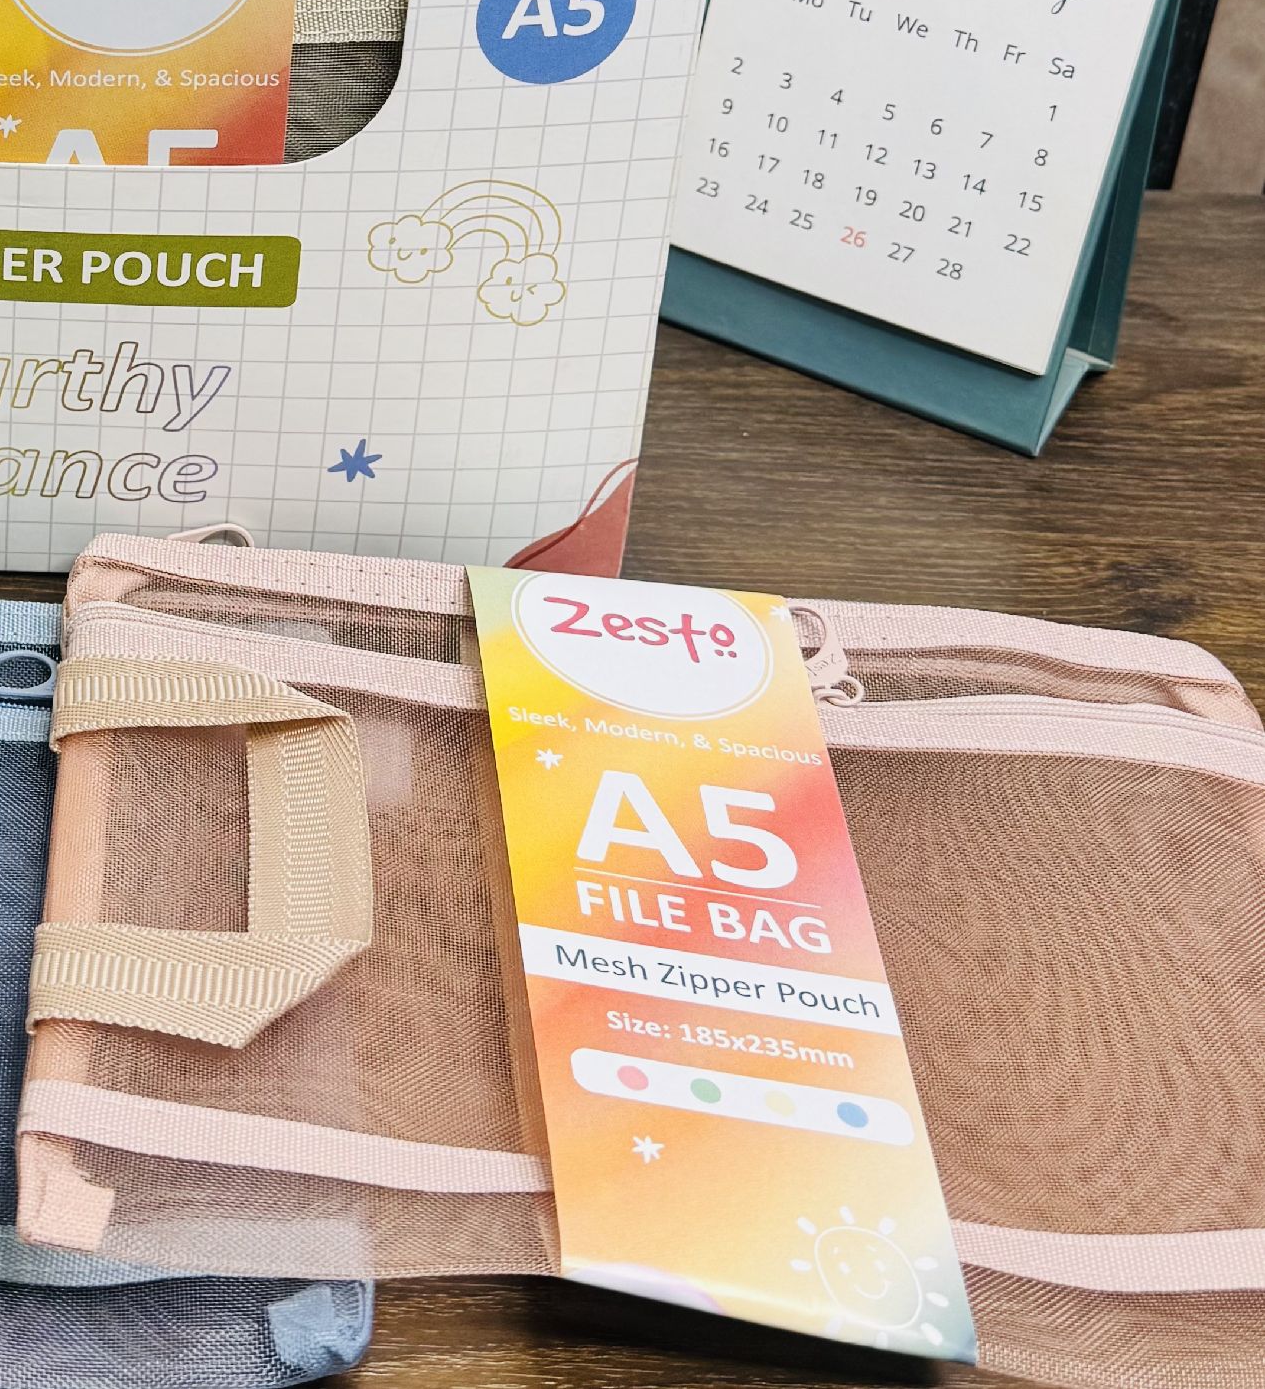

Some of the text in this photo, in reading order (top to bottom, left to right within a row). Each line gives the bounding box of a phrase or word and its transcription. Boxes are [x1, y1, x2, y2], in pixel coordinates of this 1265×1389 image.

[850, 1, 871, 21] Tu
[898, 14, 928, 37] We
[955, 30, 977, 52] Th
[1004, 45, 1026, 63] Fr
[1049, 58, 1074, 78] Sa
[49, 70, 146, 89] Modern,
[155, 70, 172, 87] &
[180, 69, 280, 91] Spacious
[731, 57, 1048, 166] 2 3 4 5 6 7 8
[1050, 105, 1056, 121] 1
[723, 99, 1043, 211] 9 10 11 12 13 14 15
[697, 178, 962, 279] 23 24 25 26 27 28
[711, 138, 1030, 256] 16 17 18 19 20 21 22
[81, 249, 264, 289] POUCH
[543, 596, 737, 664] Zesto
[508, 705, 823, 767] Sleek, Modern, & Spacious
[576, 769, 798, 890] A5
[576, 880, 832, 954] FILE BAG
[554, 943, 881, 1018] Mesh Zipper Pouch
[606, 1009, 854, 1070] Size: 185x235mm
